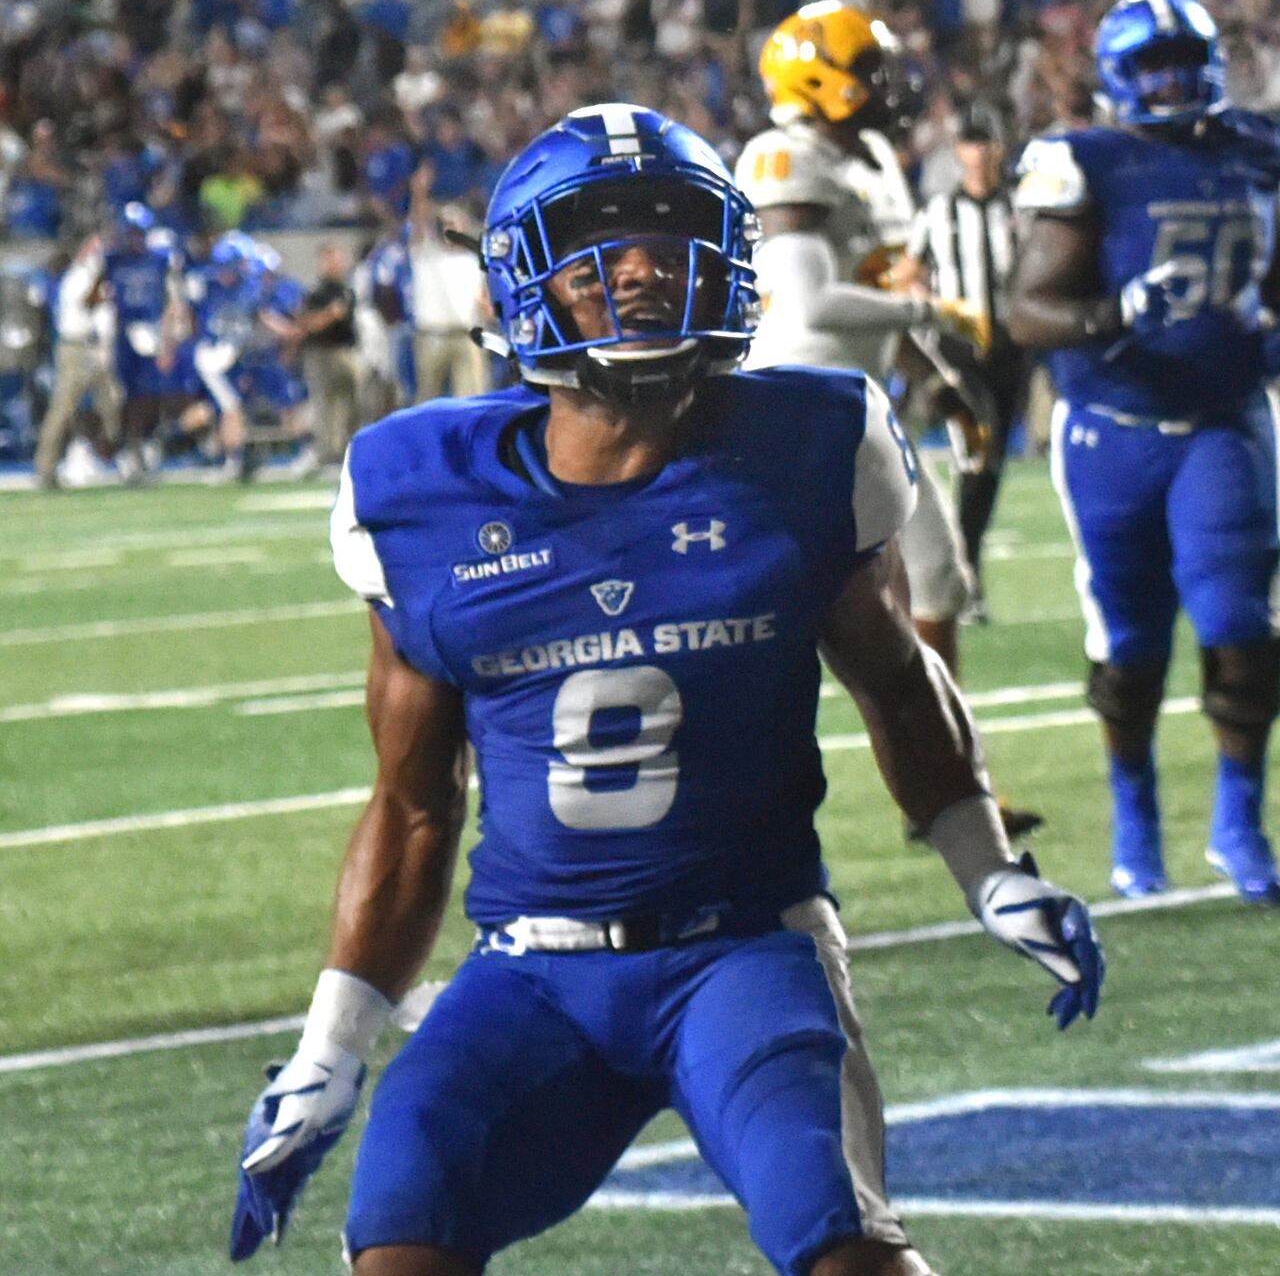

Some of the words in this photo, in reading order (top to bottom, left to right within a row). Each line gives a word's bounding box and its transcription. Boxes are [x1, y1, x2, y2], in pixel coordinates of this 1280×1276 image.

[453, 563, 500, 582] SUN
[500, 548, 551, 574] BELT
[471, 629, 644, 676] GEORGIA
[653, 614, 775, 655] STATE
[547, 665, 682, 831] 8
